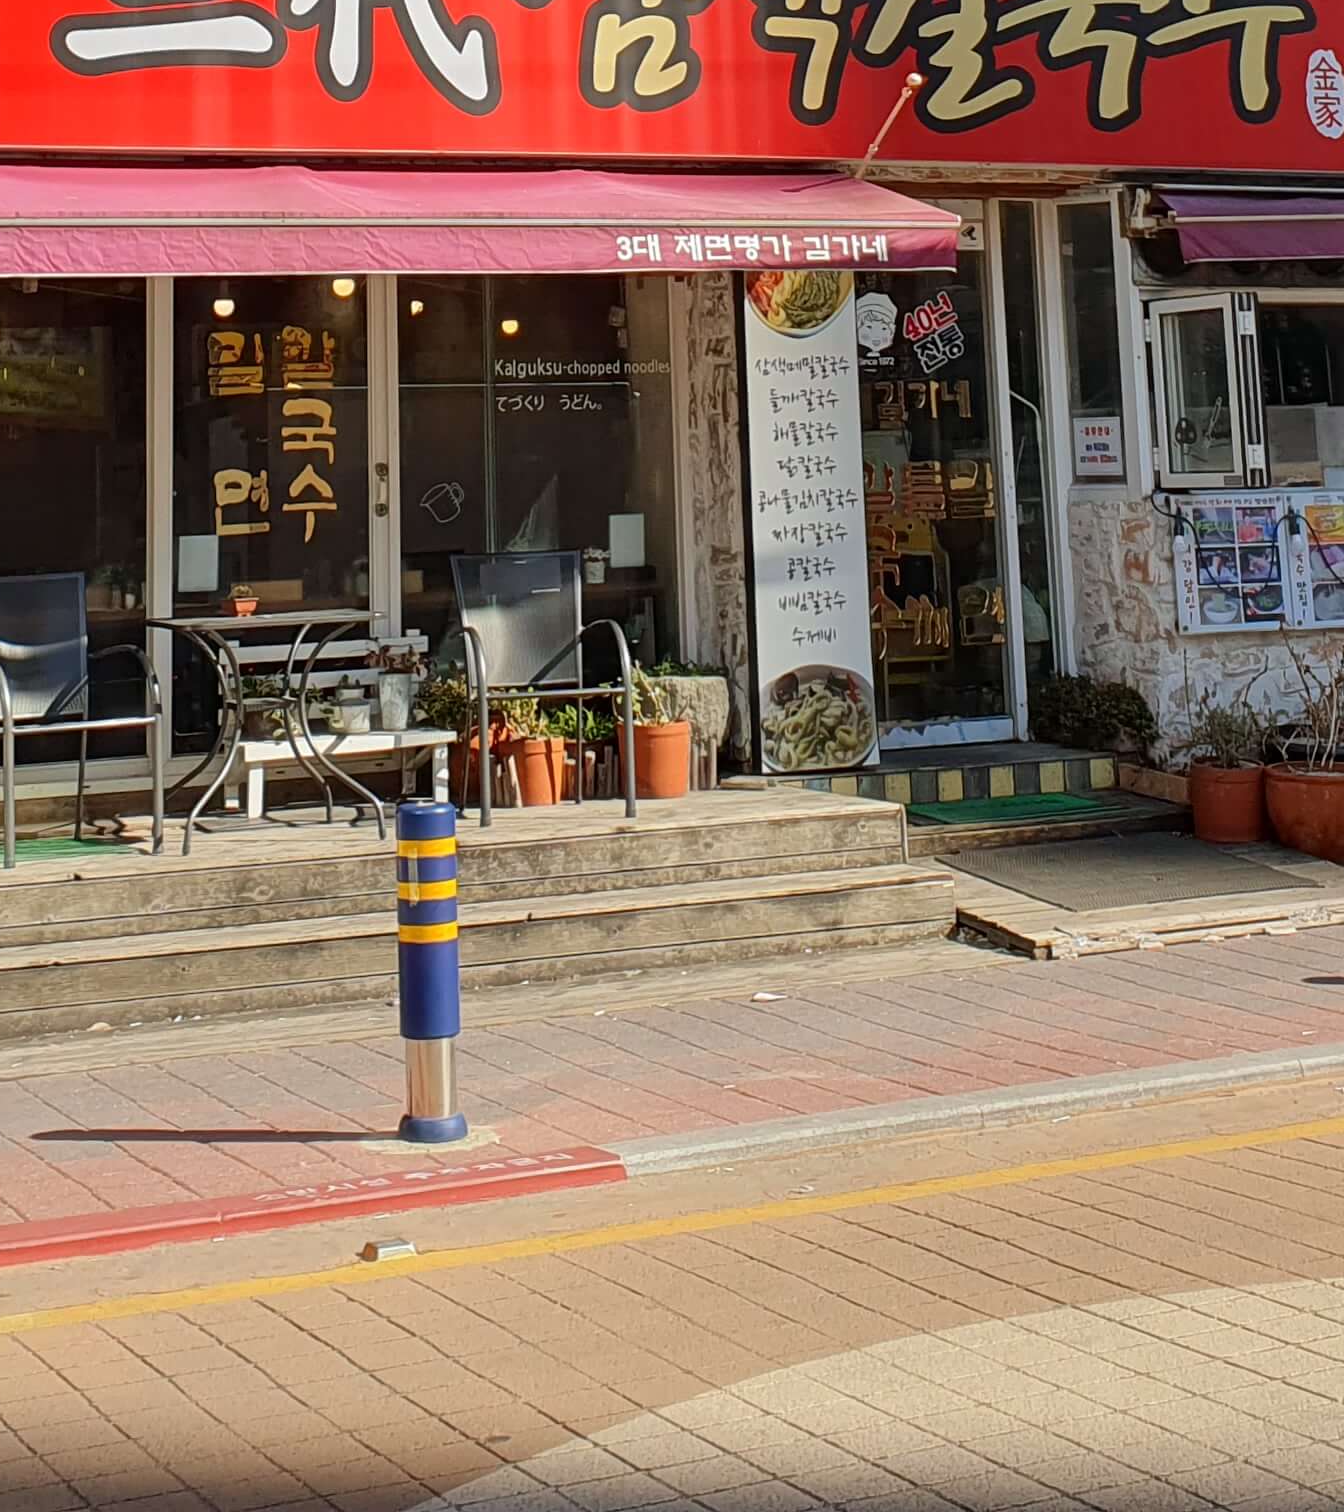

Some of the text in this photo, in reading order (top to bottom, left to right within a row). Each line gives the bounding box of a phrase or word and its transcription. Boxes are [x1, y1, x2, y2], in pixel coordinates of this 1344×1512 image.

[1308, 54, 1344, 130] 金家
[615, 232, 890, 264] 3대 제면명가 김가네
[902, 289, 959, 342] 40년
[912, 322, 965, 374] 전통
[623, 359, 671, 375] noodles
[754, 355, 851, 380] 삼색메밀칼국수
[495, 393, 545, 413] てづくり
[769, 388, 840, 414] 들깨칼국수
[772, 421, 839, 448] 해물칼국수
[776, 454, 838, 480] 닭칼국수
[757, 487, 859, 515] 콩나물김치칼국수
[771, 521, 849, 547] 짜장칼국수
[786, 556, 837, 582] 콩칼국수
[778, 589, 847, 616] 비빔칼국수
[791, 624, 838, 647] 수제비
